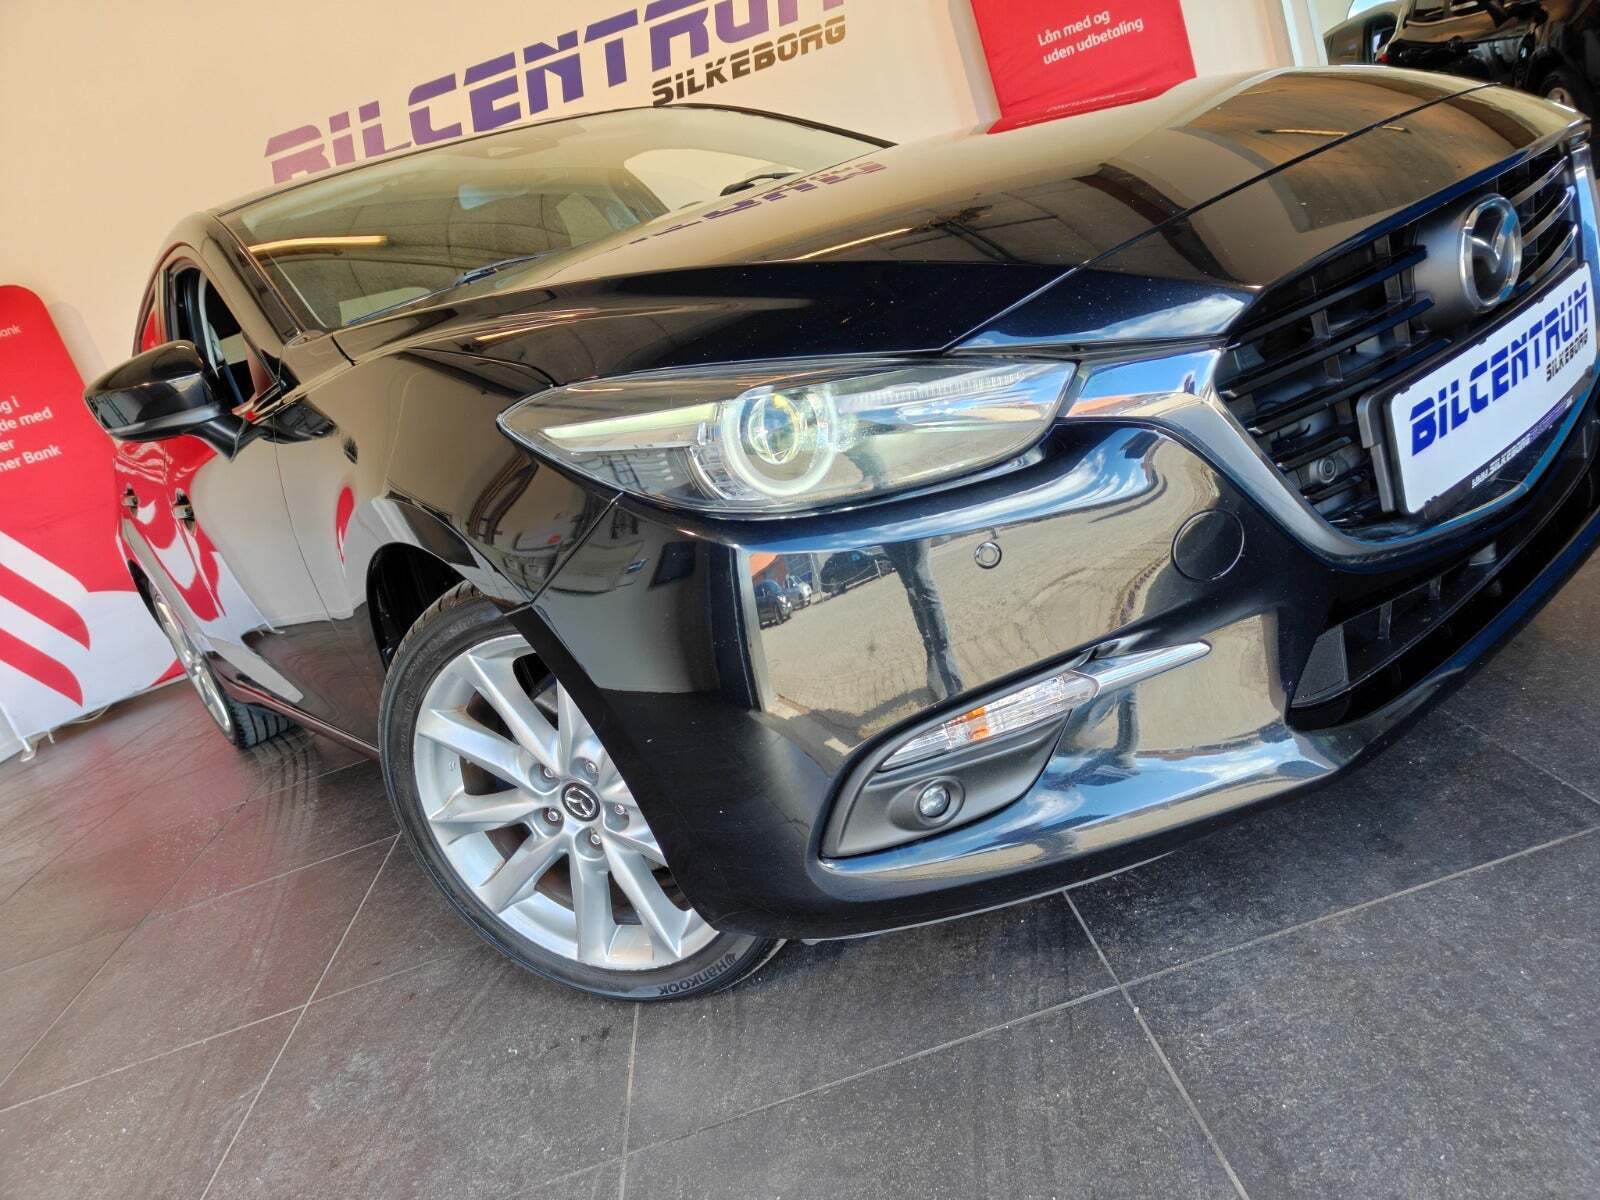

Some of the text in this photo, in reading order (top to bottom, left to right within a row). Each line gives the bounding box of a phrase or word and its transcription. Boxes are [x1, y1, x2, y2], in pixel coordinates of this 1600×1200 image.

[1038, 10, 1111, 46] Lån med og
[1043, 18, 1144, 65] uden udbetaling
[652, 15, 846, 107] SILKEBORG
[1410, 281, 1588, 456] BILCENTRUM
[20, 406, 53, 426] med
[22, 444, 62, 464] Bank
